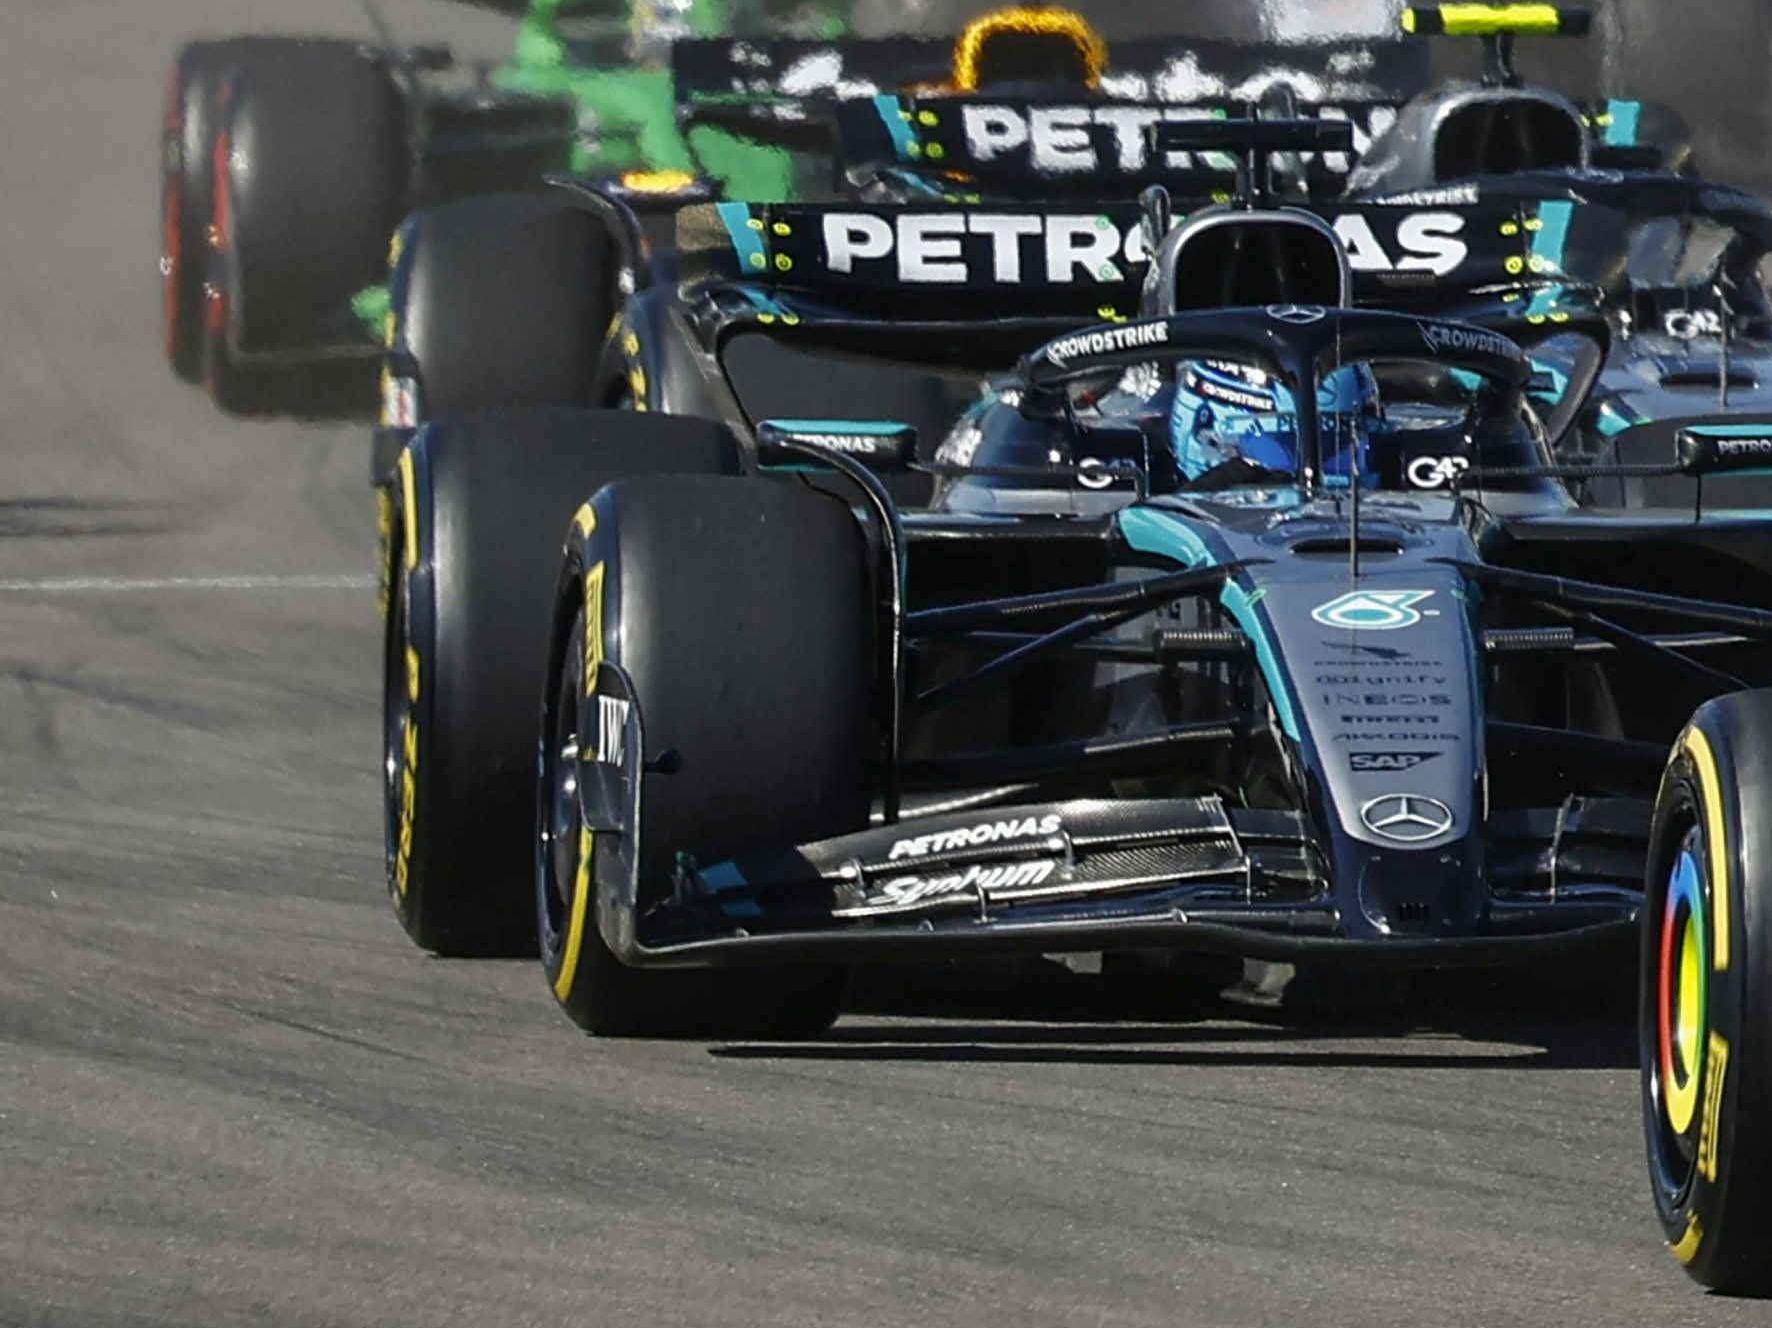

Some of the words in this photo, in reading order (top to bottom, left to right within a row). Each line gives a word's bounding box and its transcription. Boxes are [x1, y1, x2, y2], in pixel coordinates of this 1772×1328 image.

[821, 213, 1468, 282] PETRAS
[1050, 321, 1169, 360] CROWDSTRIKE
[1323, 693, 1452, 706] INEOS
[1350, 753, 1423, 769] SAP
[888, 814, 1062, 860] PETRONAS
